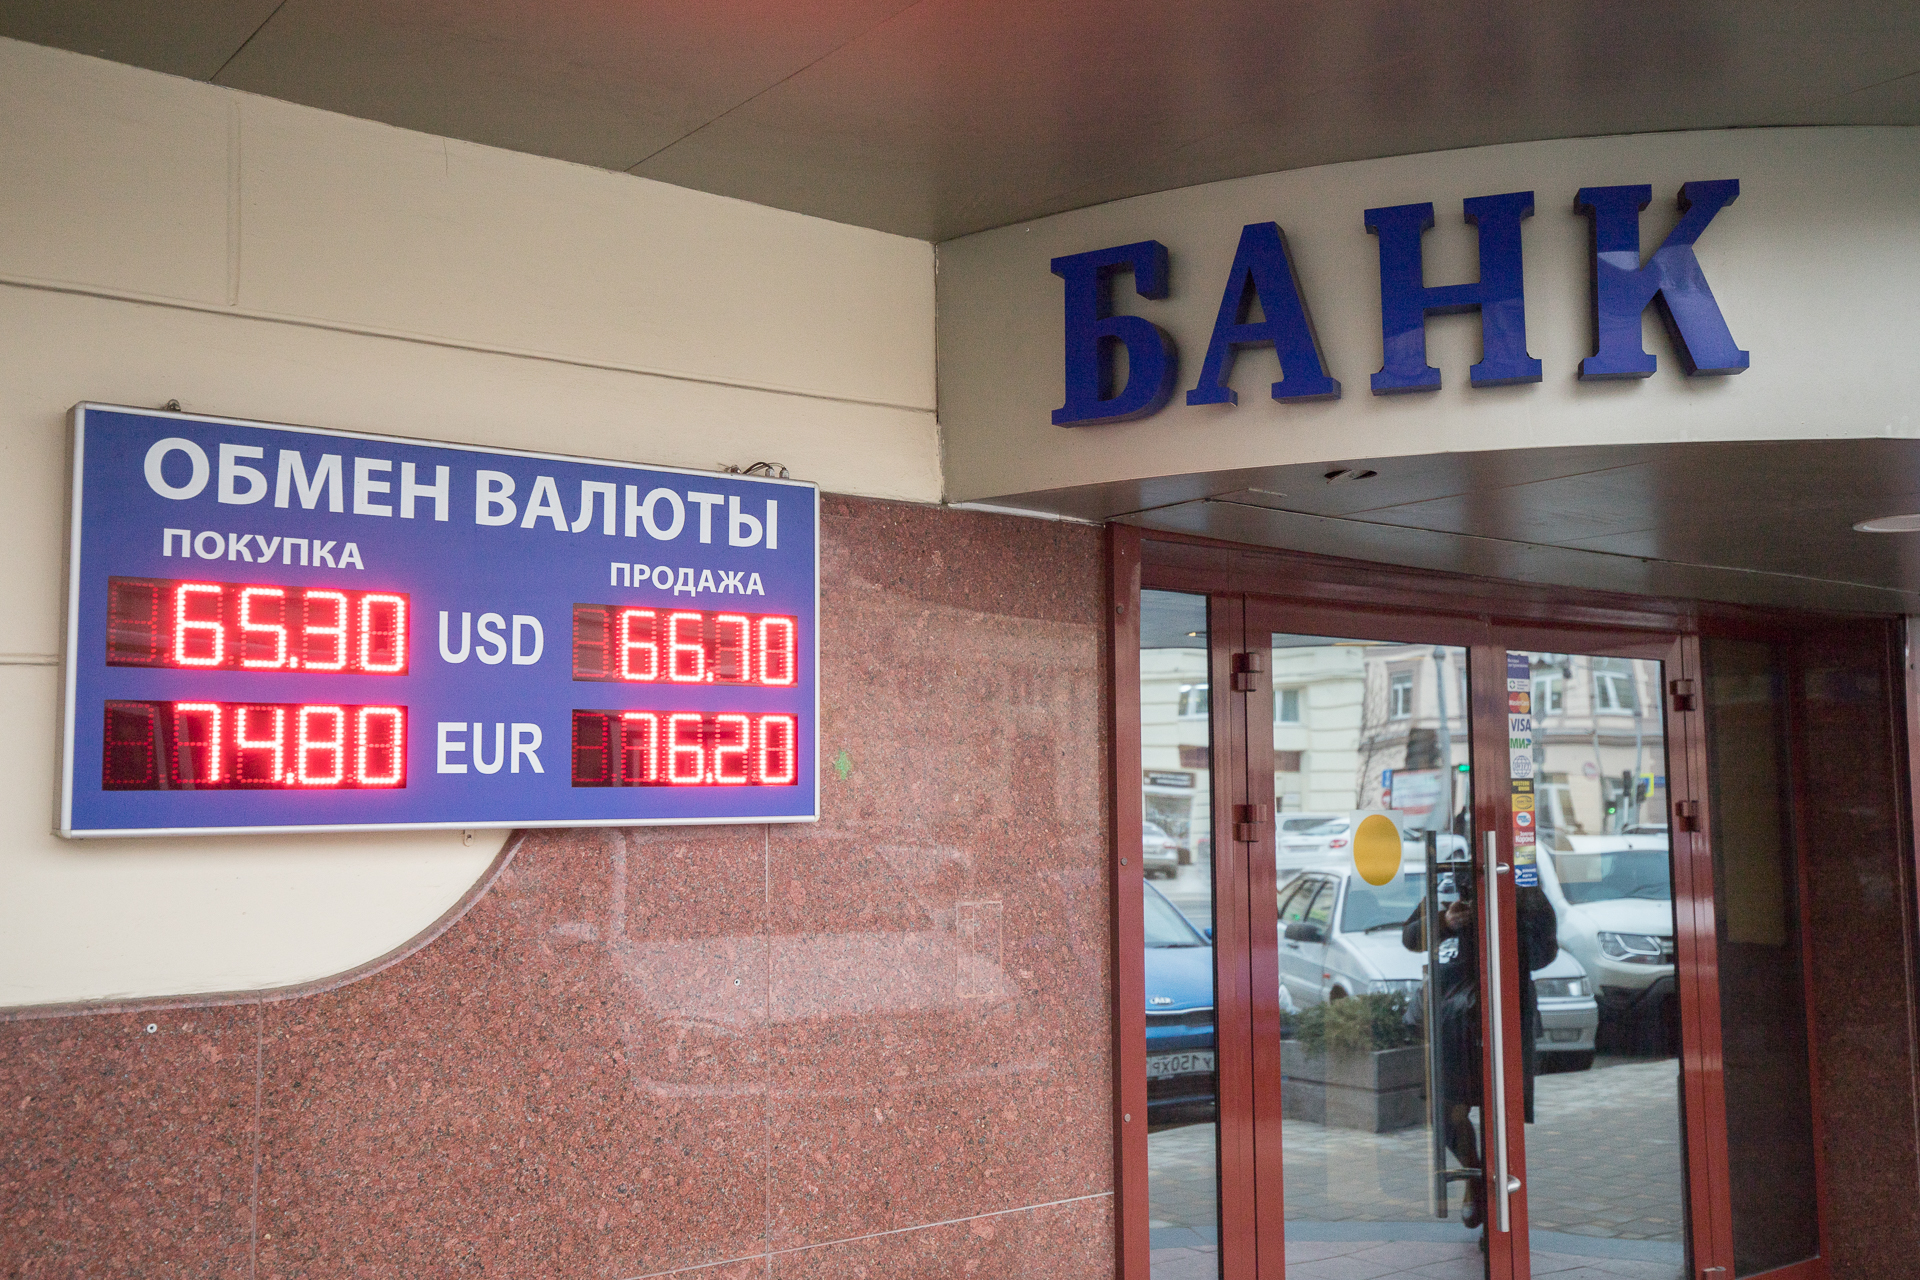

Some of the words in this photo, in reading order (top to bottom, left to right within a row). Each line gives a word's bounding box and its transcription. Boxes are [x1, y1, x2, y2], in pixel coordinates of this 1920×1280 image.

[1051, 179, 1749, 428] БАНК
[143, 437, 451, 523] ОБМЕН
[475, 469, 778, 550] ВАЛЮТЫ
[162, 527, 365, 571] ПОКУПКА
[610, 561, 766, 598] ПРОДАЖА
[174, 583, 405, 673] 65.30
[438, 610, 545, 666] USD
[620, 609, 795, 685] 66.70
[173, 702, 403, 786] 74.80
[436, 721, 545, 775] EUR
[621, 711, 795, 785] 76.20
[1510, 718, 1531, 731] VISA
[1510, 738, 1532, 748] МИР
